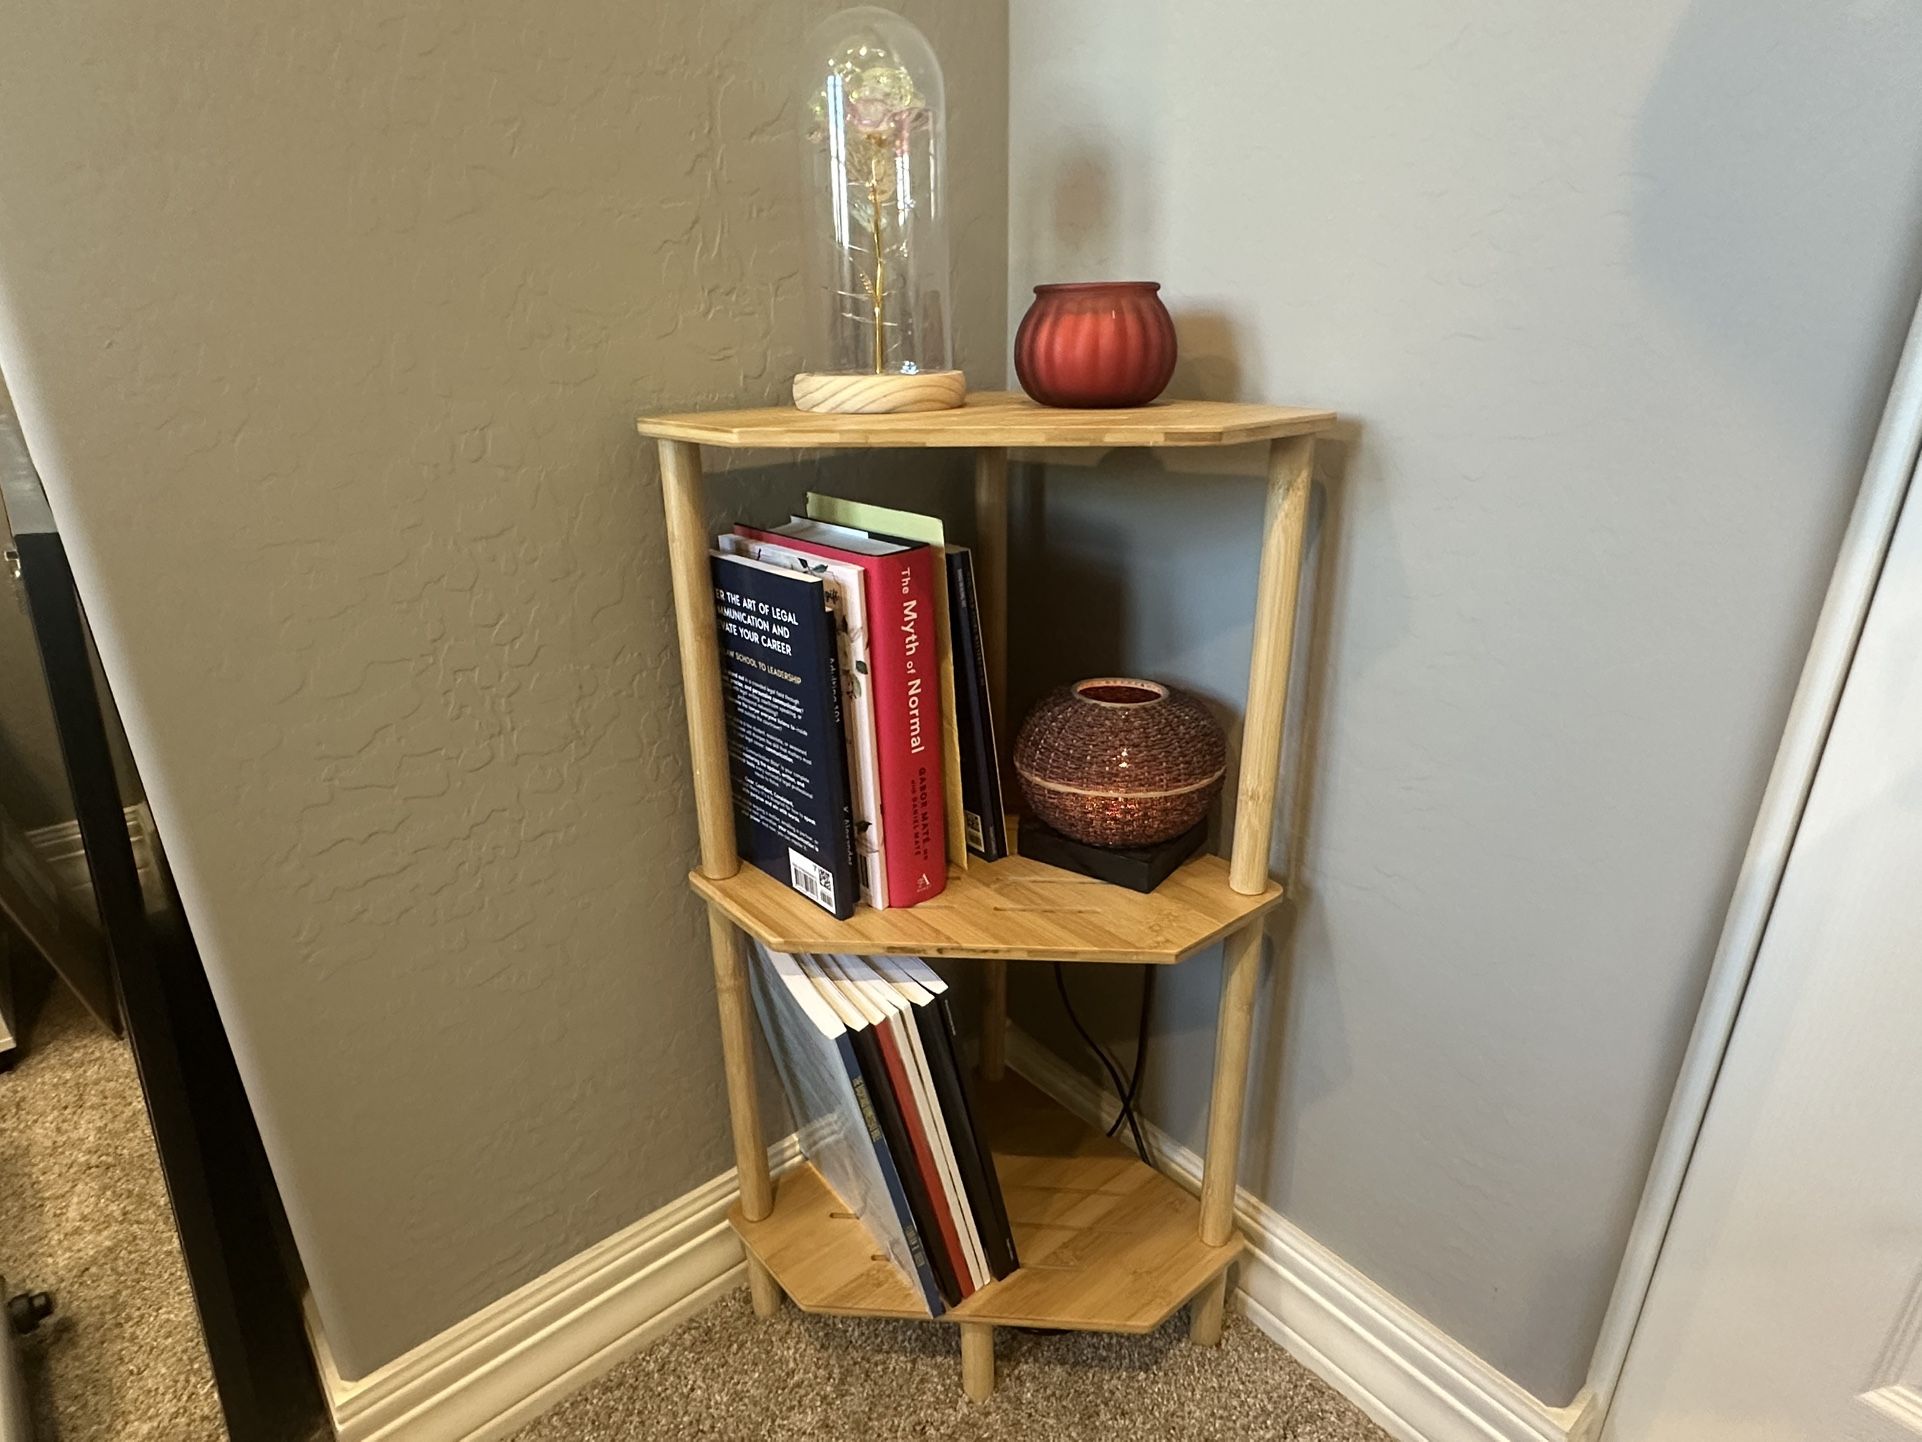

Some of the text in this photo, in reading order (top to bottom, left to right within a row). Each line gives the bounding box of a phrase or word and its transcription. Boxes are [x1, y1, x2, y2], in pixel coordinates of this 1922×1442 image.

[726, 591, 740, 606] THE
[741, 596, 756, 612] ART
[758, 601, 769, 616] OF
[771, 606, 798, 625] LEGAL
[738, 626, 759, 644] YOUR
[760, 634, 791, 656] CAREER
[770, 622, 790, 639] AND
[735, 651, 757, 668] SCHOOL
[758, 660, 766, 672] TO
[767, 664, 801, 686] LEADERSHIP
[900, 567, 925, 753] The Myth of Normal
[919, 767, 928, 808] GABOR
